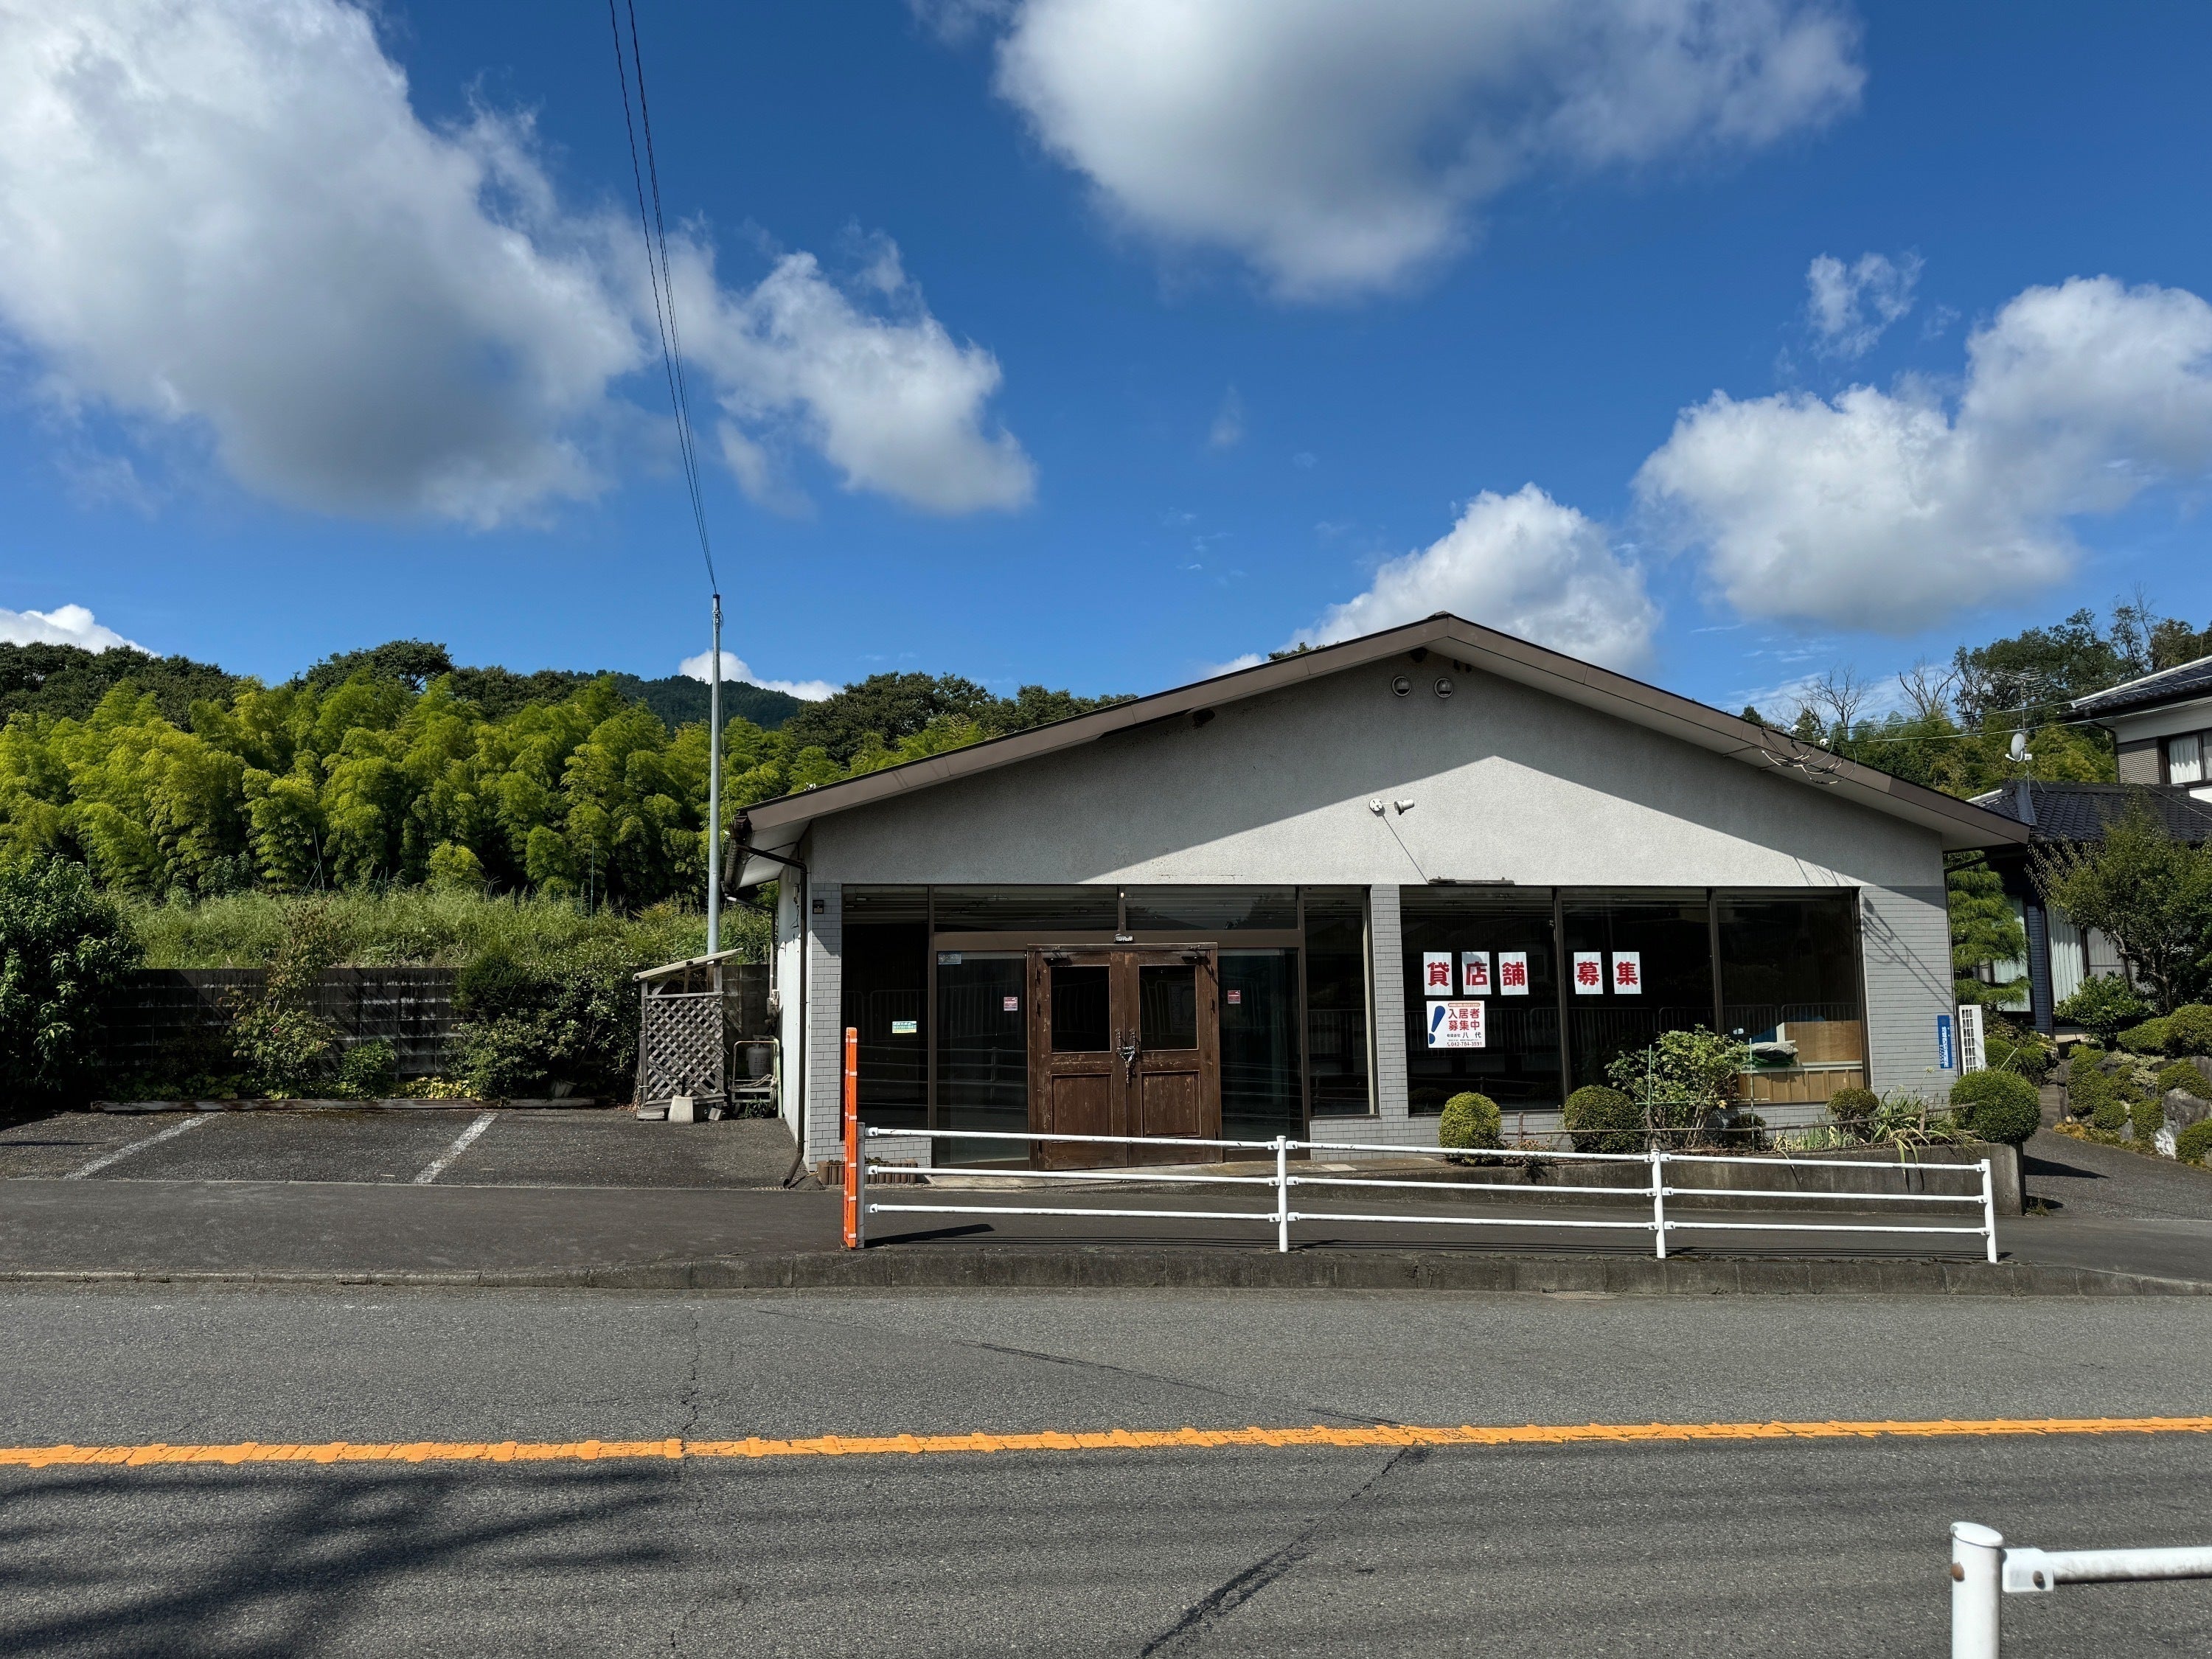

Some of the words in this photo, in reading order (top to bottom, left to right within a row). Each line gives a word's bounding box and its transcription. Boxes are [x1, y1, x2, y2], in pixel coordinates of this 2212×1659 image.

[1427, 961, 1526, 987] 貸店舗
[1576, 961, 1638, 986] 募集
[1448, 1008, 1480, 1019] 入居者
[1448, 1020, 1480, 1031] 募集中
